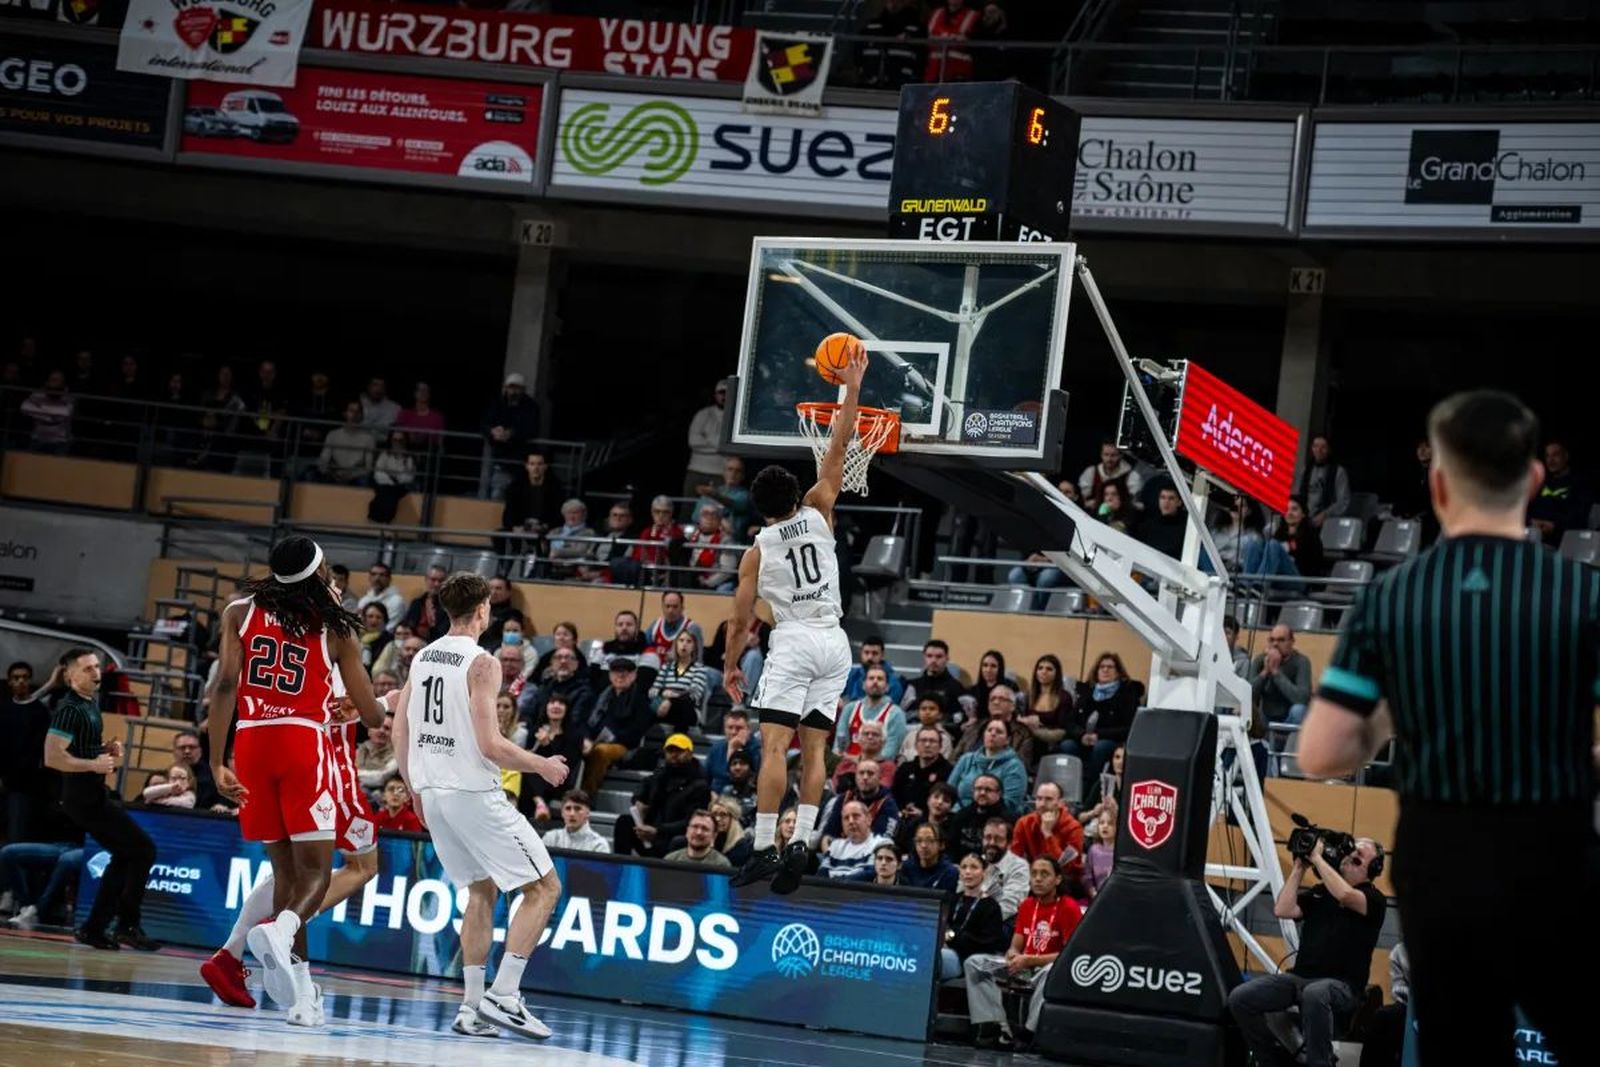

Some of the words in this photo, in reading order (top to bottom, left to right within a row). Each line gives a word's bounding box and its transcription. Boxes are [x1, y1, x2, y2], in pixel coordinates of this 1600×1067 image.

[322, 8, 577, 68] WÜRZBURG
[600, 17, 733, 60] YOUNG
[149, 55, 267, 74] international
[346, 88, 367, 100] LES
[88, 114, 151, 134] PROJETS
[316, 100, 358, 114] LOUEZ
[359, 104, 388, 116] AUX
[390, 107, 468, 123] ALENTOURS.
[475, 156, 505, 172] ada
[1079, 138, 1196, 172] Chalon
[1092, 171, 1194, 204] Saône
[918, 216, 977, 241] EGT
[1201, 403, 1274, 477] Adecco
[779, 519, 809, 542] MINTZ
[785, 543, 822, 589] 10
[247, 634, 309, 695] 25
[263, 703, 296, 715] VICKY
[422, 676, 444, 725] 19
[1134, 793, 1174, 815] CHALON
[823, 935, 907, 955] BASKETBALL
[821, 964, 873, 981] LEAGUE
[822, 948, 917, 973] CHAMPIONS
[1127, 965, 1202, 995] suez
